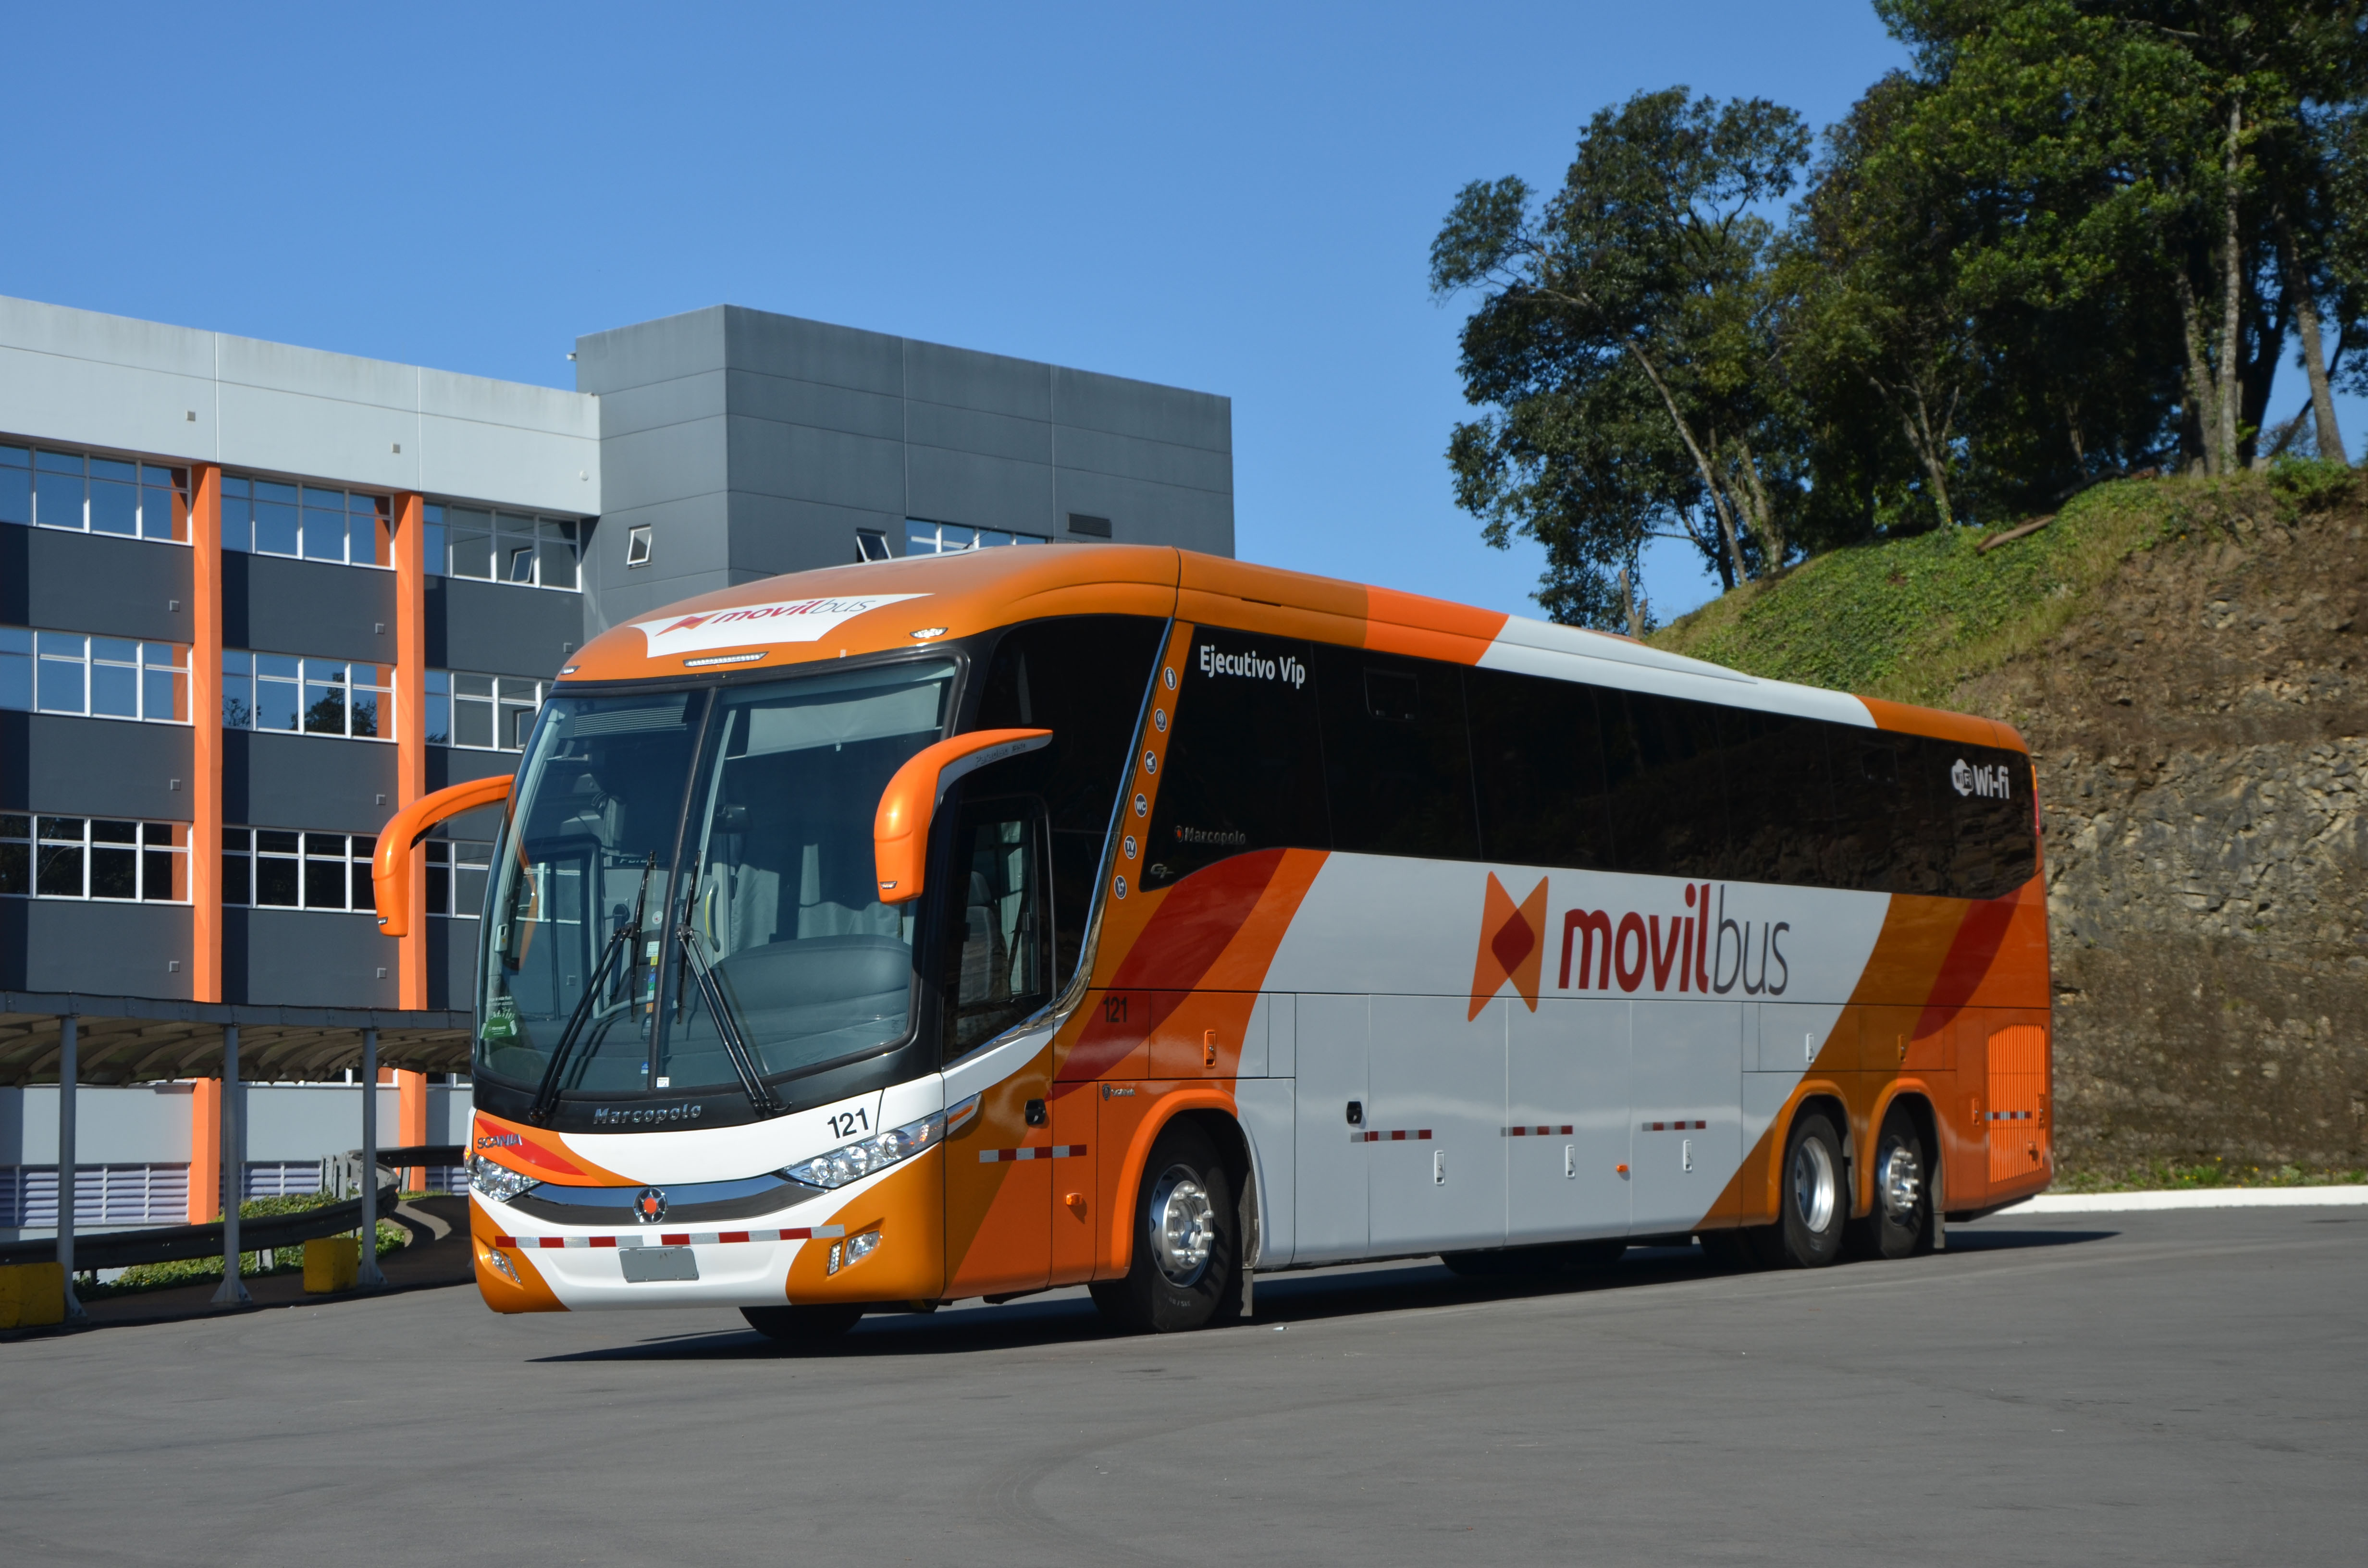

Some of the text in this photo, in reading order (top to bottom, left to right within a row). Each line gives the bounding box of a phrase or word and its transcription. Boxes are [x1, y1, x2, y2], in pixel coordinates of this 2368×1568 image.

[711, 599, 876, 624] movilbus
[1200, 644, 1305, 689] Ejecutivo Vip
[1136, 800, 1146, 811] WC
[1126, 840, 1135, 851] TV
[1184, 827, 1246, 845] Marcopolo
[1558, 882, 1790, 995] movilbus
[1103, 996, 1127, 1023] 121
[593, 1103, 702, 1124] Marcopolo
[827, 1107, 869, 1139] 121
[477, 1133, 523, 1149] SCANIA
